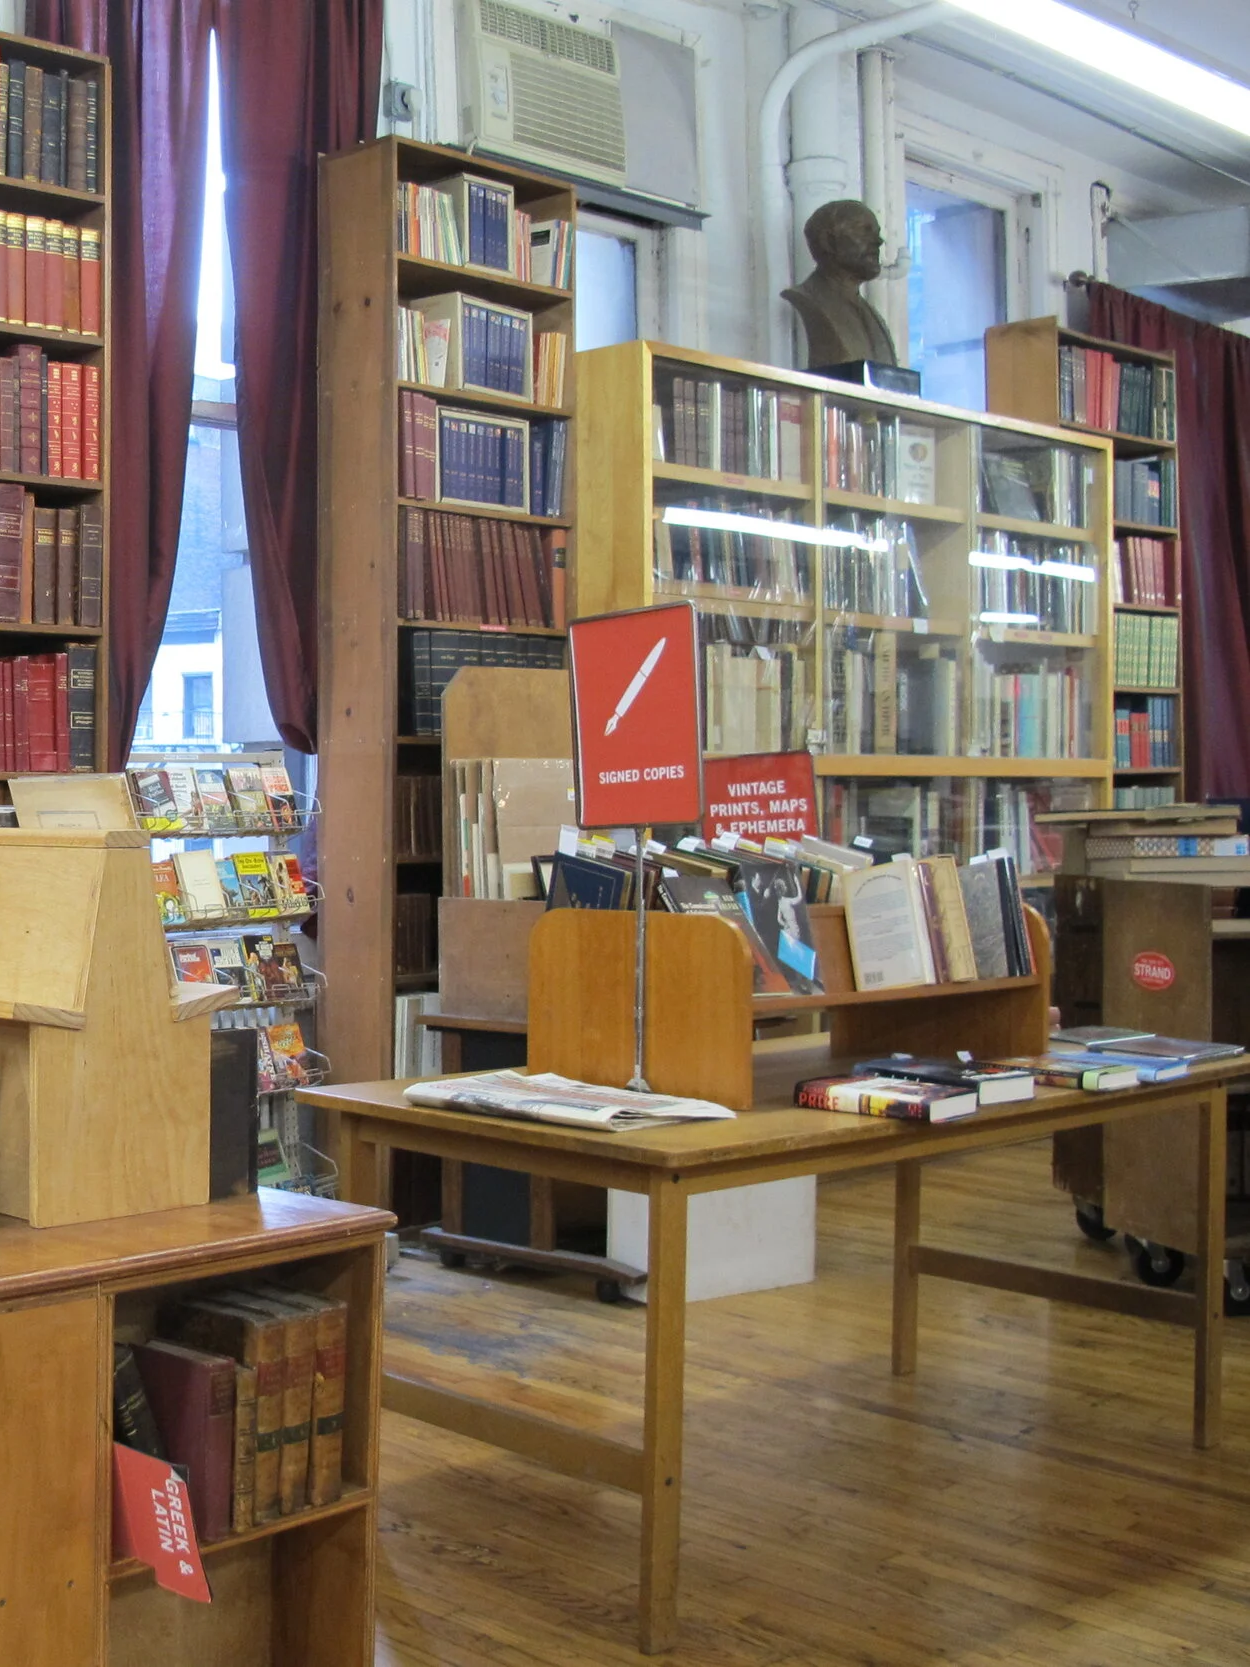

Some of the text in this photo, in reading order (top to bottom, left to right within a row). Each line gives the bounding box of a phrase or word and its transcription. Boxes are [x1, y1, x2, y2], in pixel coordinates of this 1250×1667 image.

[598, 765, 684, 784] SIGNED COPIES
[728, 780, 786, 798] VINTAGE
[710, 798, 808, 818] PRINTS, MAPS
[716, 818, 806, 836] & EPHEMERA
[1134, 962, 1171, 980] STRAND
[151, 1488, 174, 1553] LATIN
[165, 1478, 194, 1575] GREEK &
